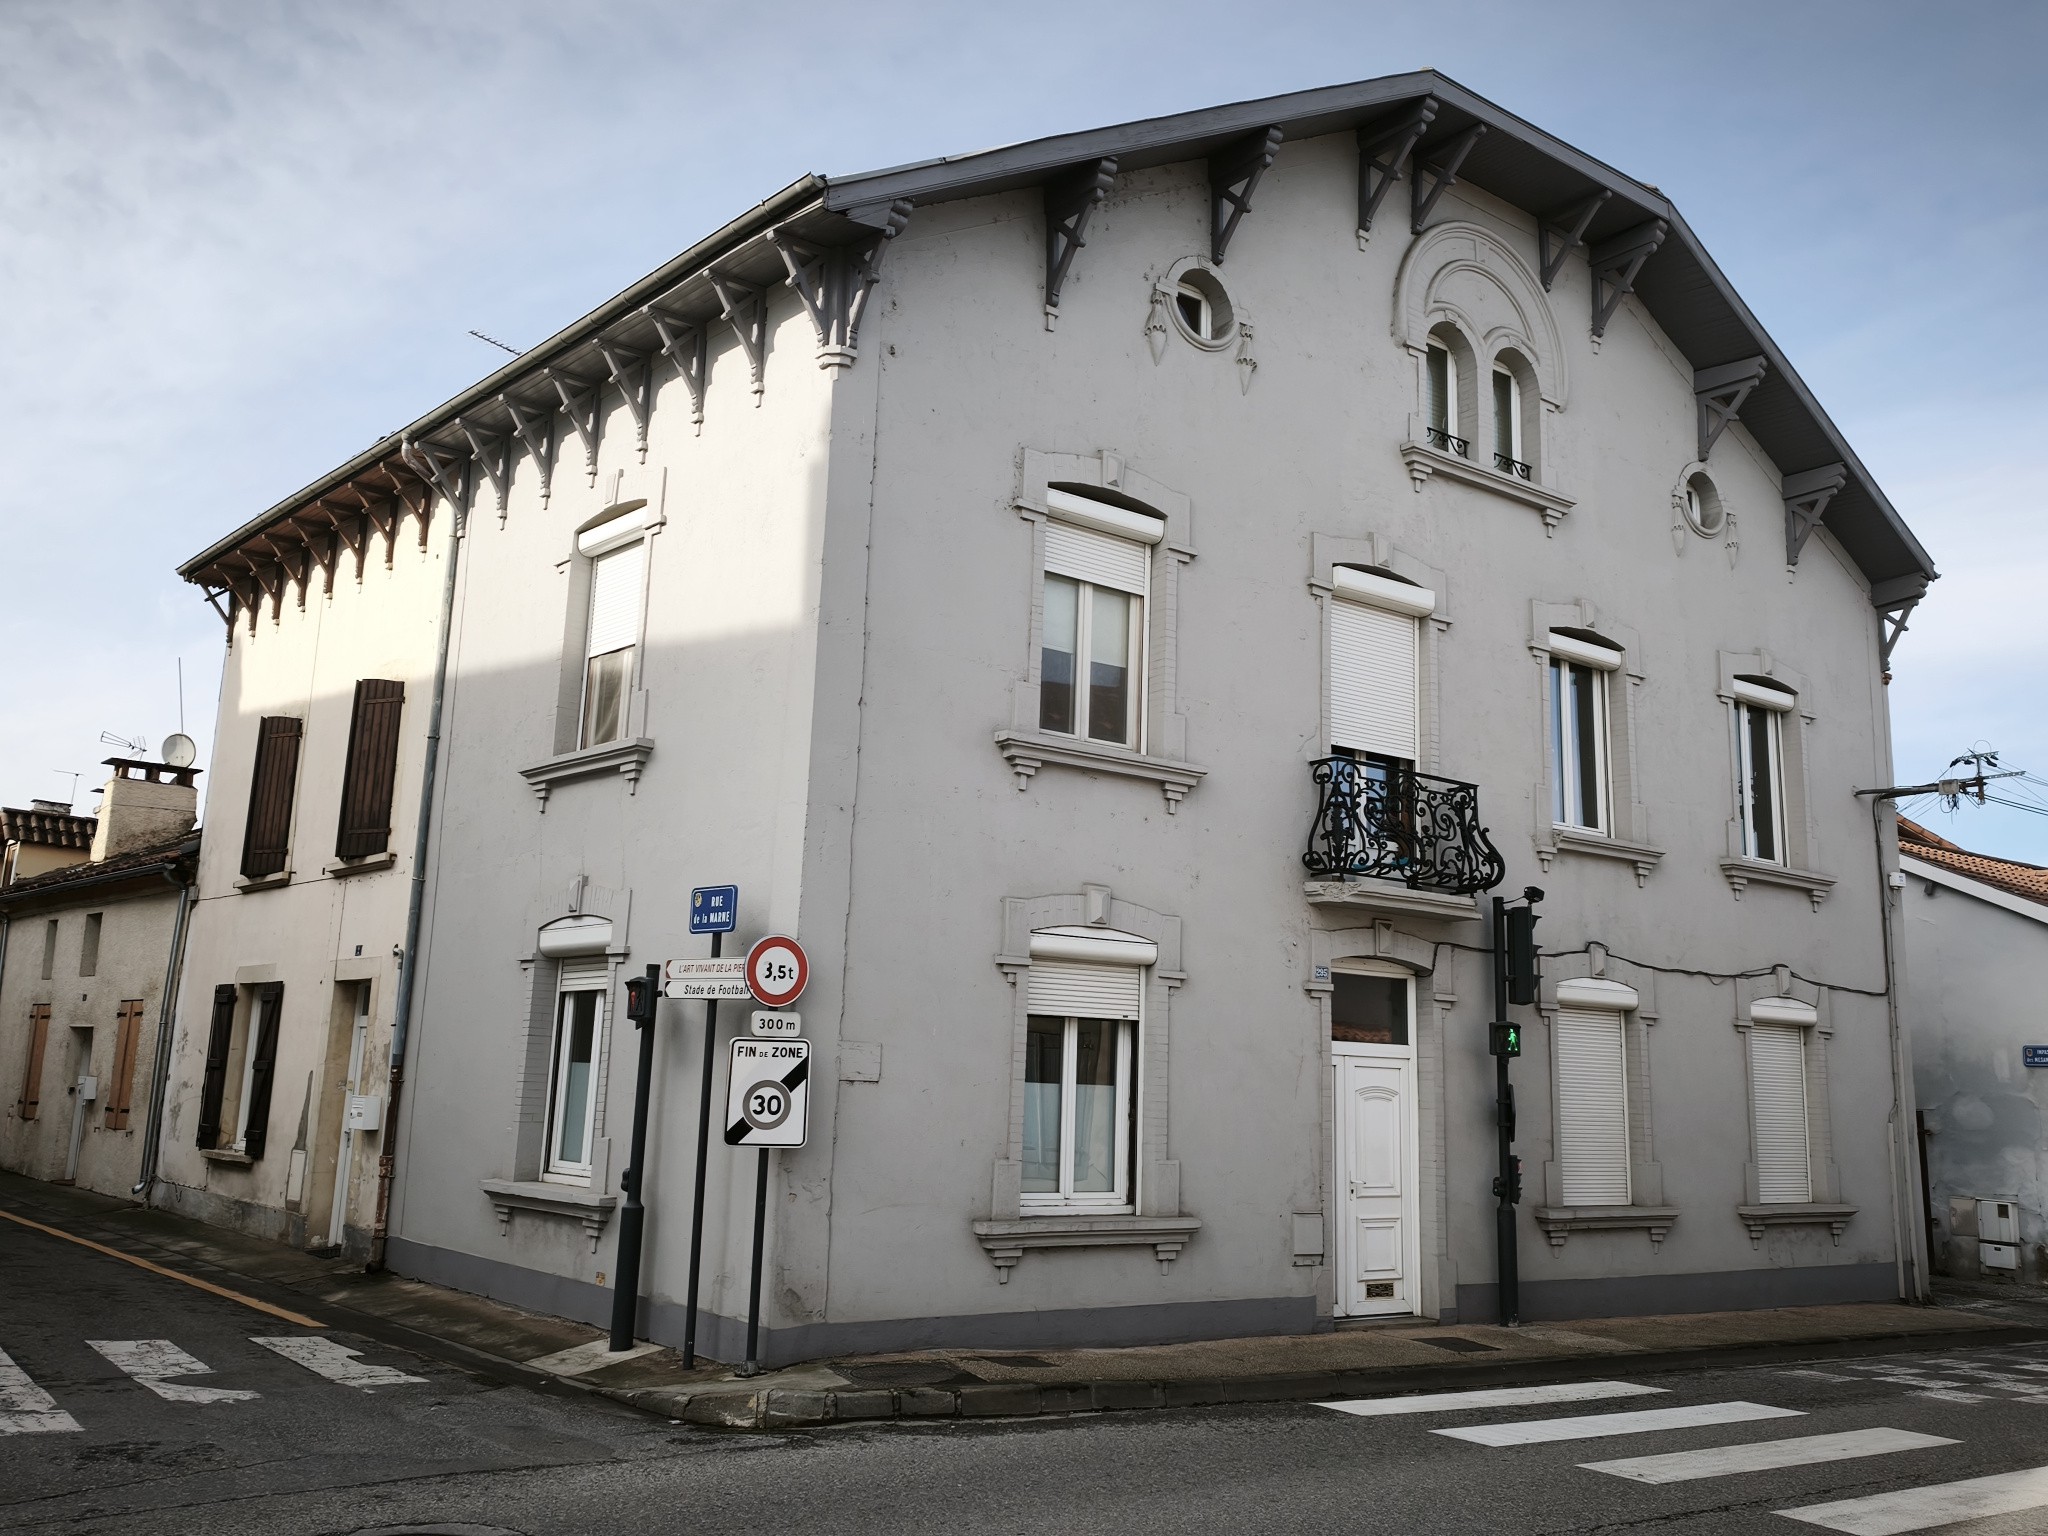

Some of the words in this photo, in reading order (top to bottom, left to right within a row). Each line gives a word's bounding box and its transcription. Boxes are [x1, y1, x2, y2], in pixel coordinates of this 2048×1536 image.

[711, 895, 723, 907] RUE
[693, 913, 700, 924] de
[702, 913, 708, 924] la
[709, 911, 730, 923] MARNE
[679, 964, 695, 973] L'ART
[695, 964, 715, 973] VIVANT
[716, 964, 724, 973] DE
[724, 964, 732, 973] LA
[684, 984, 704, 995] Stade
[706, 984, 716, 995] de
[759, 1018, 783, 1030] 300
[786, 1021, 796, 1031] m
[737, 1046, 757, 1057] FIN
[771, 1047, 804, 1058] ZONE
[752, 1094, 782, 1116] 30
